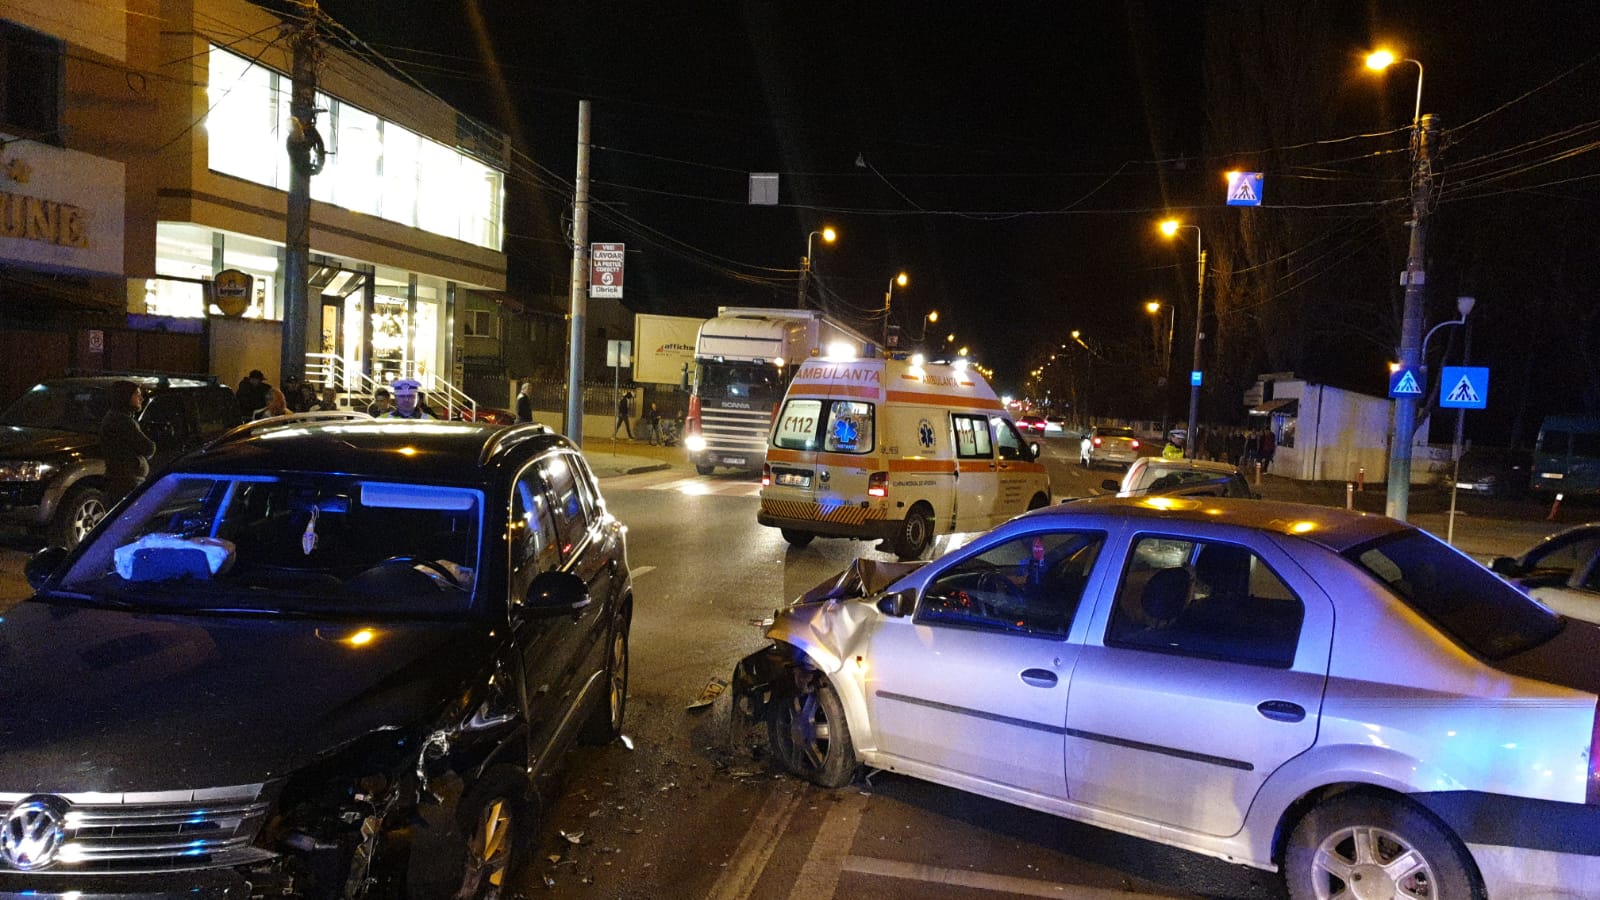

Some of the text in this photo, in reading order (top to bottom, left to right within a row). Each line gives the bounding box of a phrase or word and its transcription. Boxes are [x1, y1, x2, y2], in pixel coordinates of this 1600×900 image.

[796, 367, 881, 383] AMBULANTA
[922, 374, 960, 388] AMBULANTA
[792, 416, 814, 433] 112
